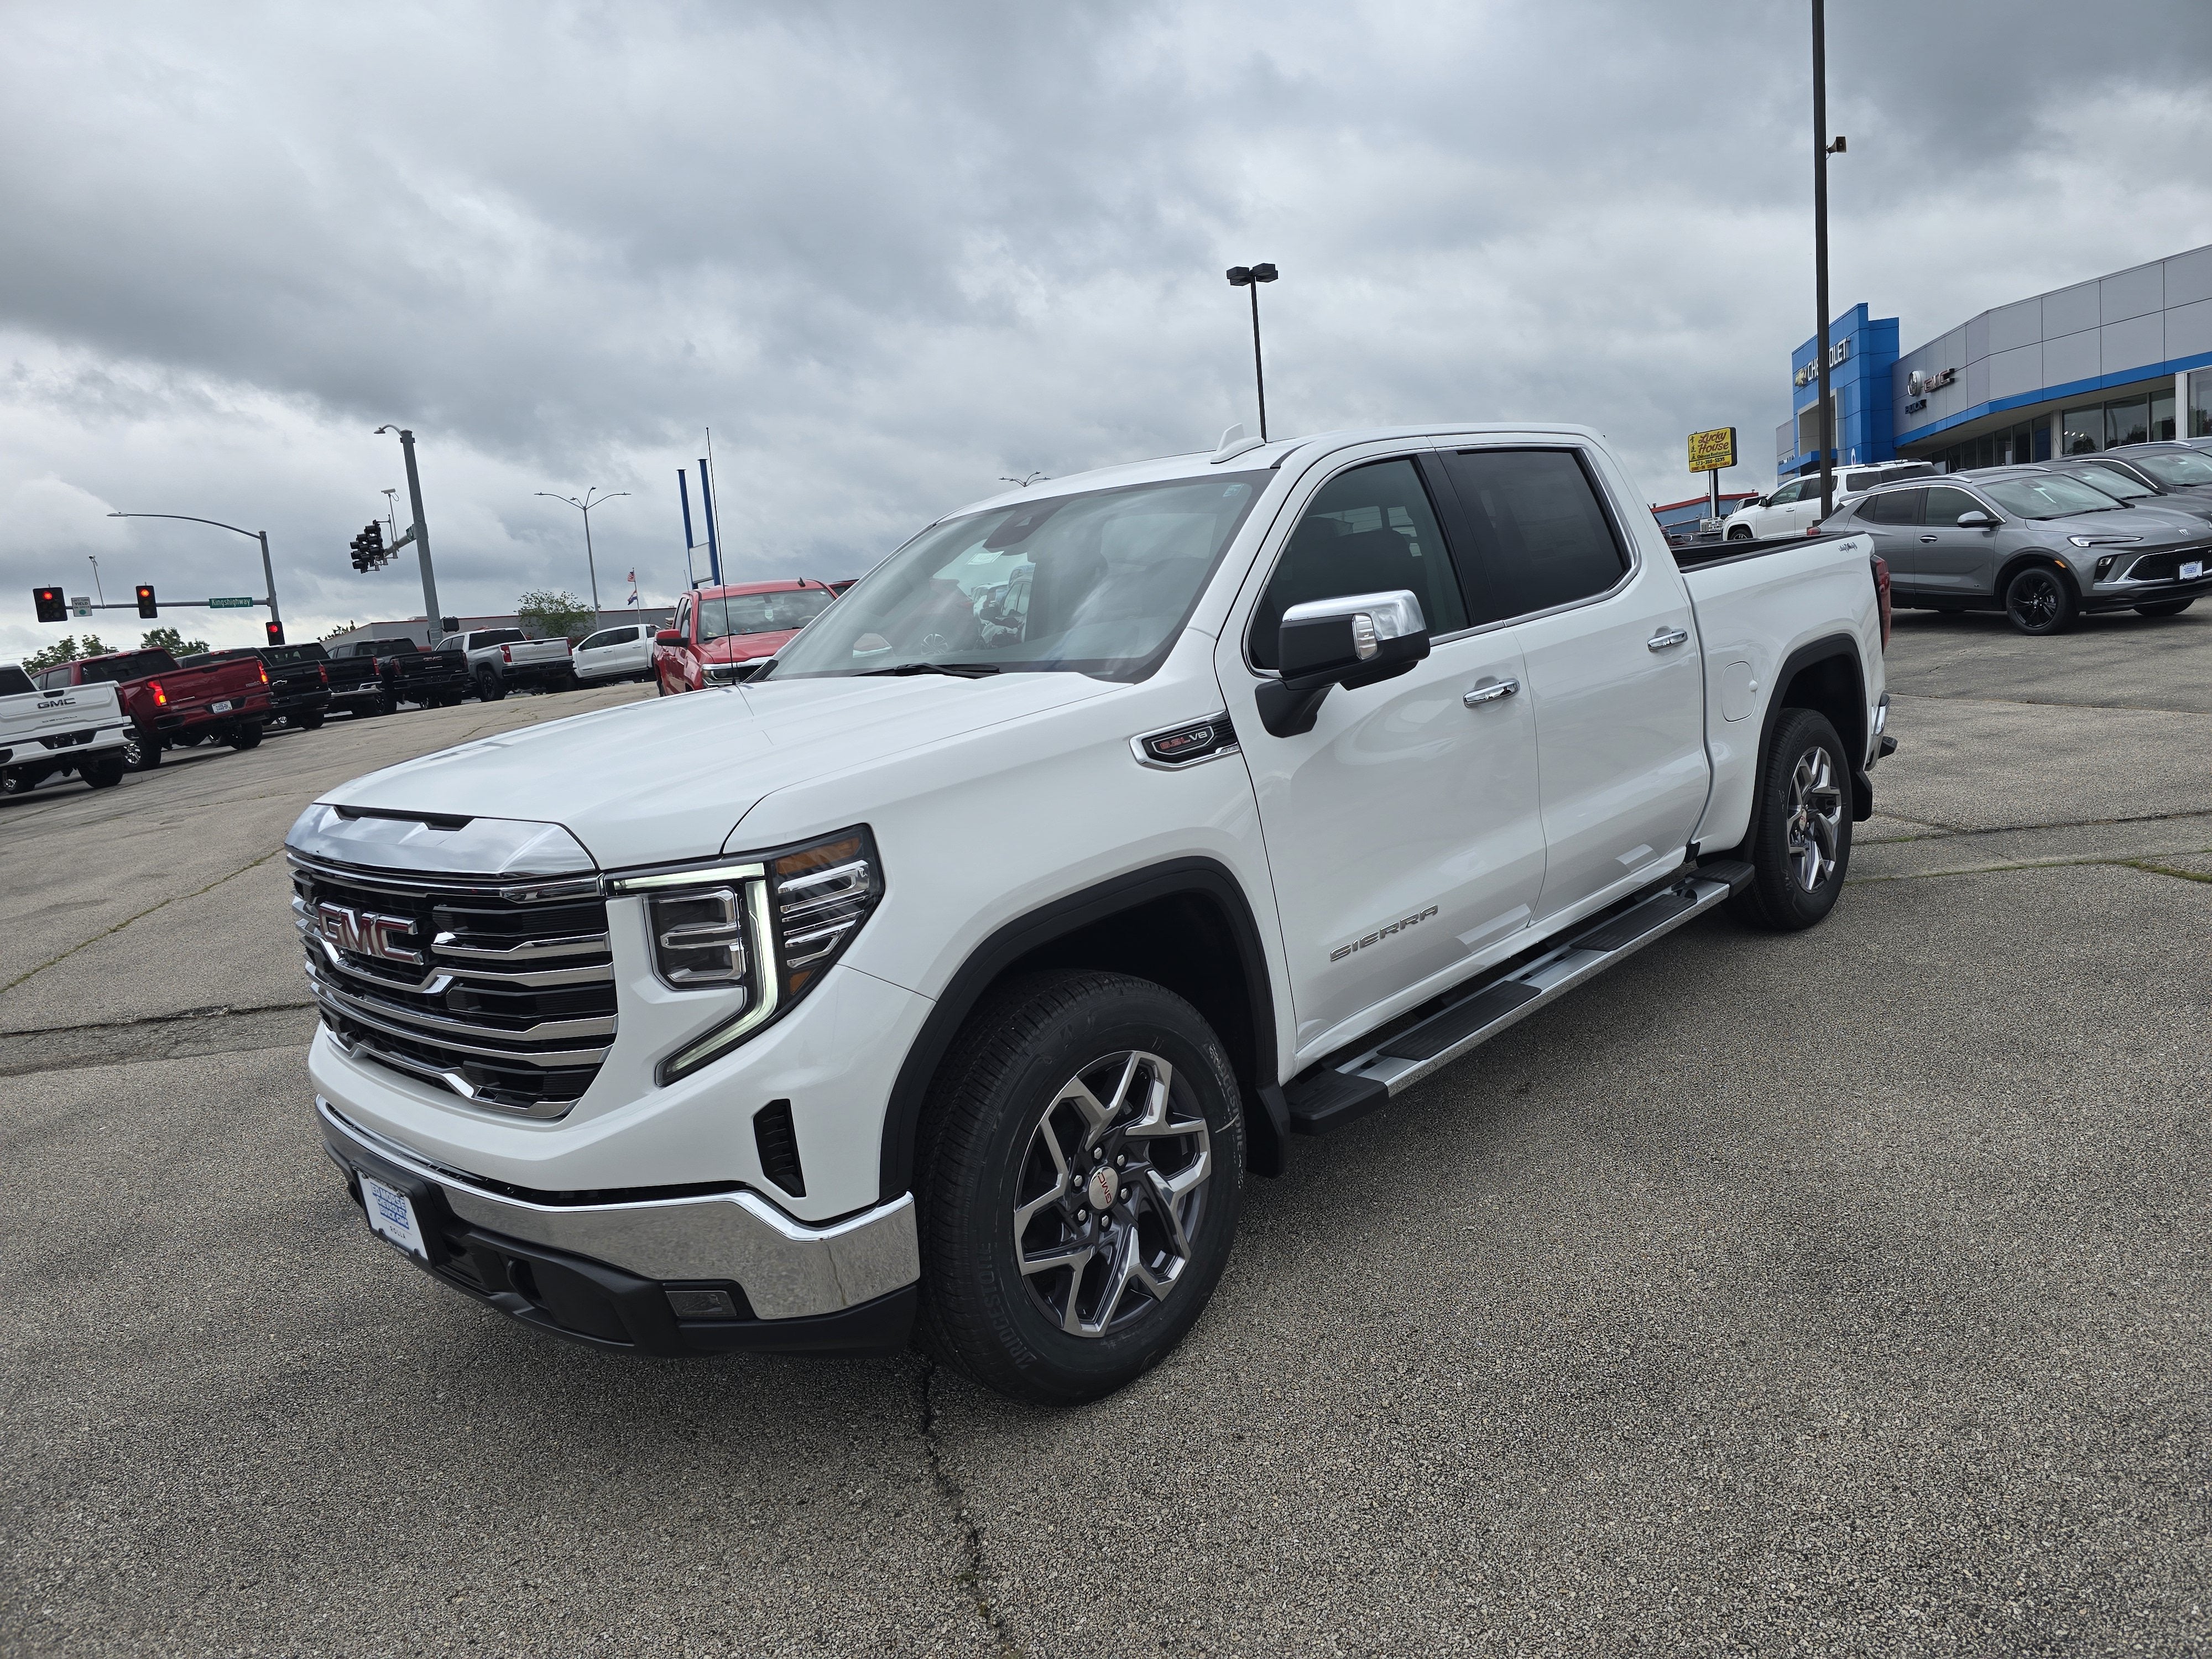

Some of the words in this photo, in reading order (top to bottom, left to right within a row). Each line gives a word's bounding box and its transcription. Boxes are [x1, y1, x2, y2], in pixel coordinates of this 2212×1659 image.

[1807, 337, 1850, 382] CHEOLET
[1923, 368, 1954, 393] GMC
[1905, 399, 1927, 414] BUICK
[1698, 431, 1727, 444] Lucky
[1698, 442, 1729, 453] House
[211, 598, 251, 607] Kingshighway
[37, 698, 76, 709] GMC
[318, 901, 424, 965] GMC
[1330, 904, 1438, 962] SIERRA
[372, 1185, 380, 1197] ED
[380, 1188, 406, 1211] MORSE
[1098, 1172, 1112, 1204] GMC
[377, 1196, 406, 1218] CHEVROLET
[389, 1225, 406, 1239] ROLLA
